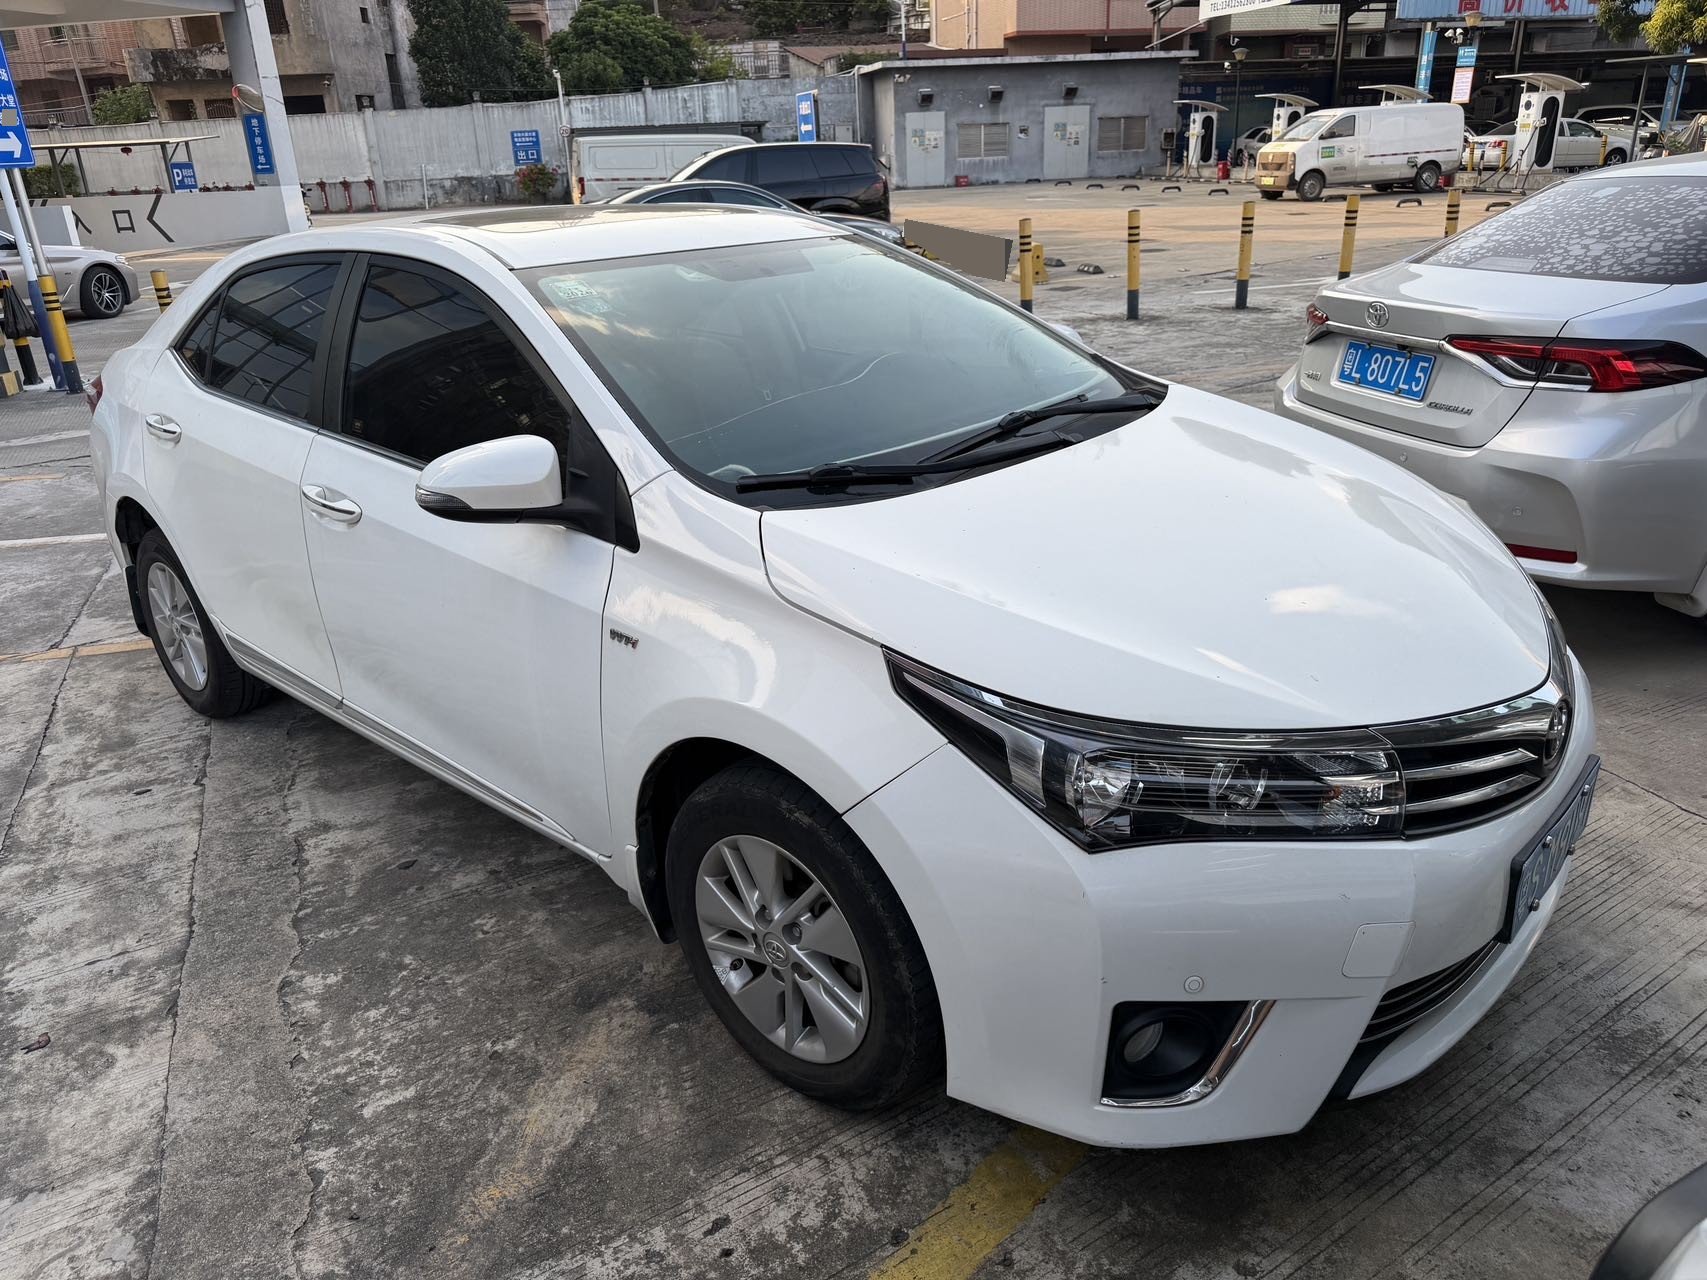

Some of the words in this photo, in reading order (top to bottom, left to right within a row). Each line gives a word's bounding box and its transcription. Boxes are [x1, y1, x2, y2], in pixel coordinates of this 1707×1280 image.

[250, 118, 267, 164] 地下停车场
[517, 150, 537, 160] 出口
[173, 168, 183, 186] P
